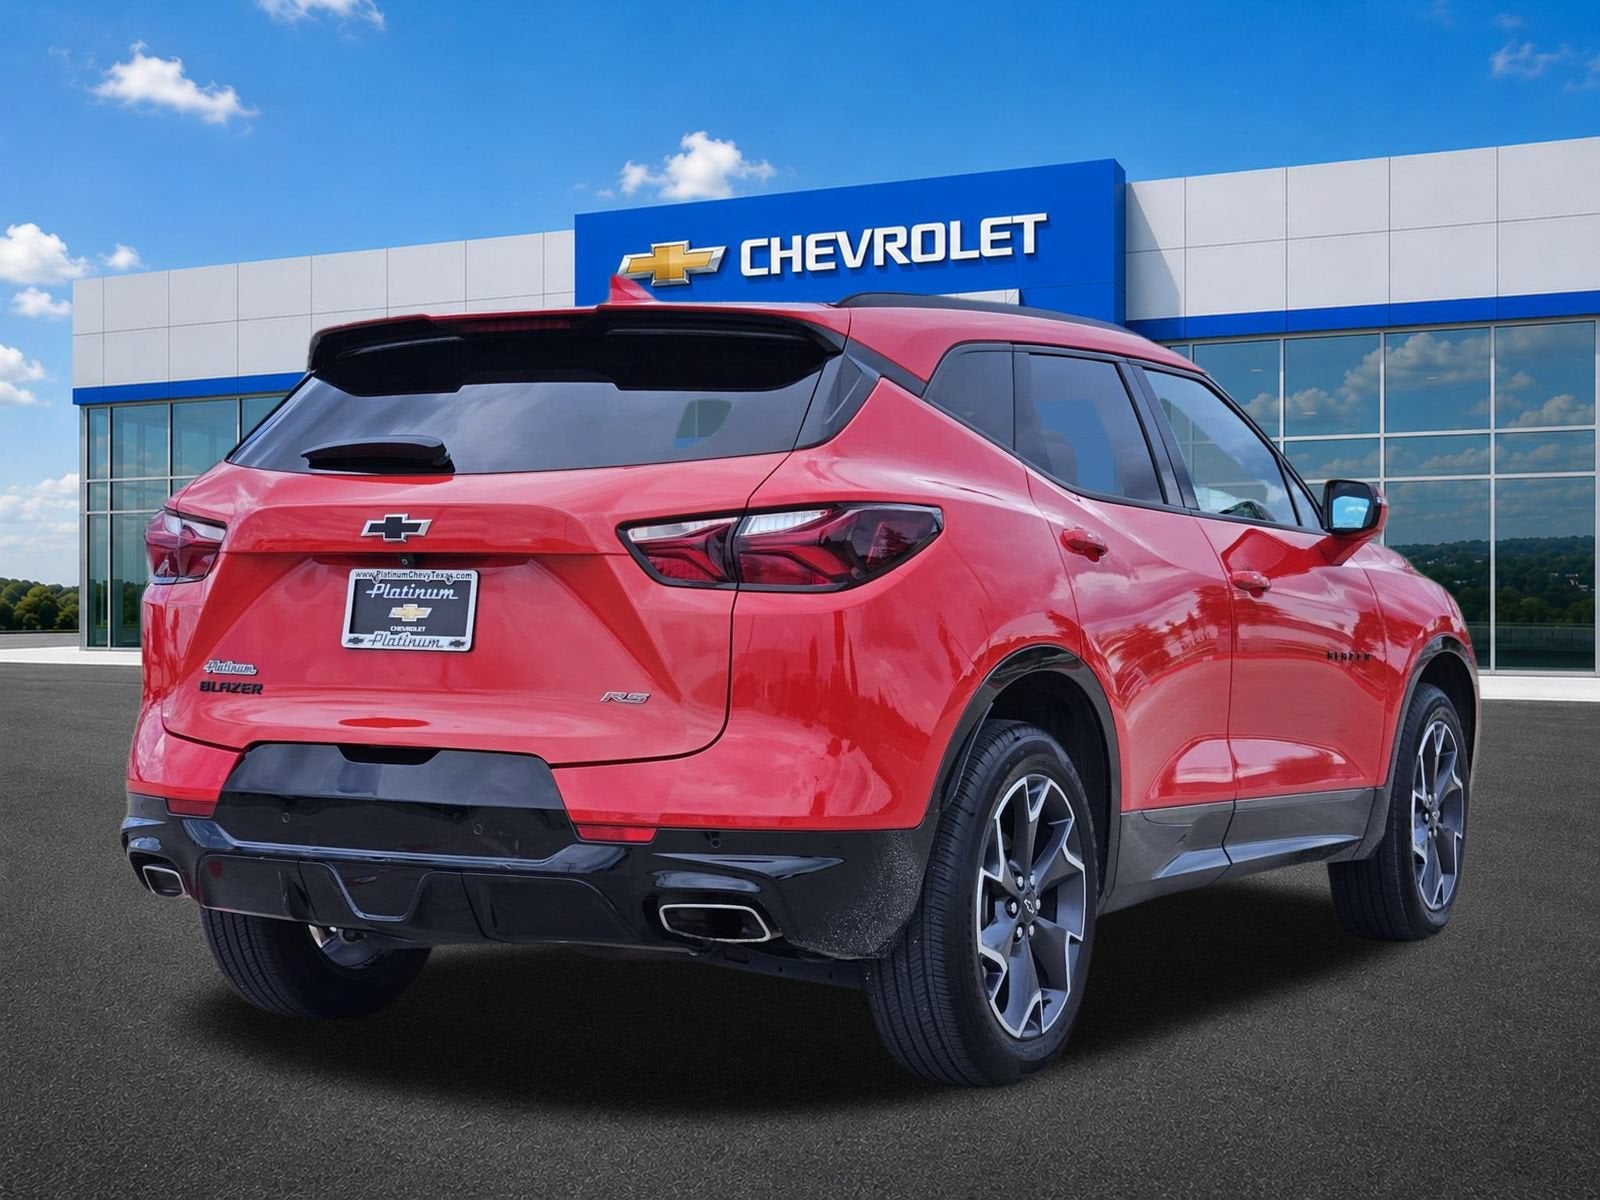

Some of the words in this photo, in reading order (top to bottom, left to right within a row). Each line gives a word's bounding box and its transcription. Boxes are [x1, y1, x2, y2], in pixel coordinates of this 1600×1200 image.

[740, 212, 1047, 277] CHEVROLET
[355, 570, 473, 581] www.PlatinumChevyTexas.com
[366, 583, 459, 599] Platinum
[368, 632, 444, 648] Platinum
[203, 660, 257, 675] Platinum
[200, 681, 263, 695] BLAZER
[600, 691, 651, 704] RS
